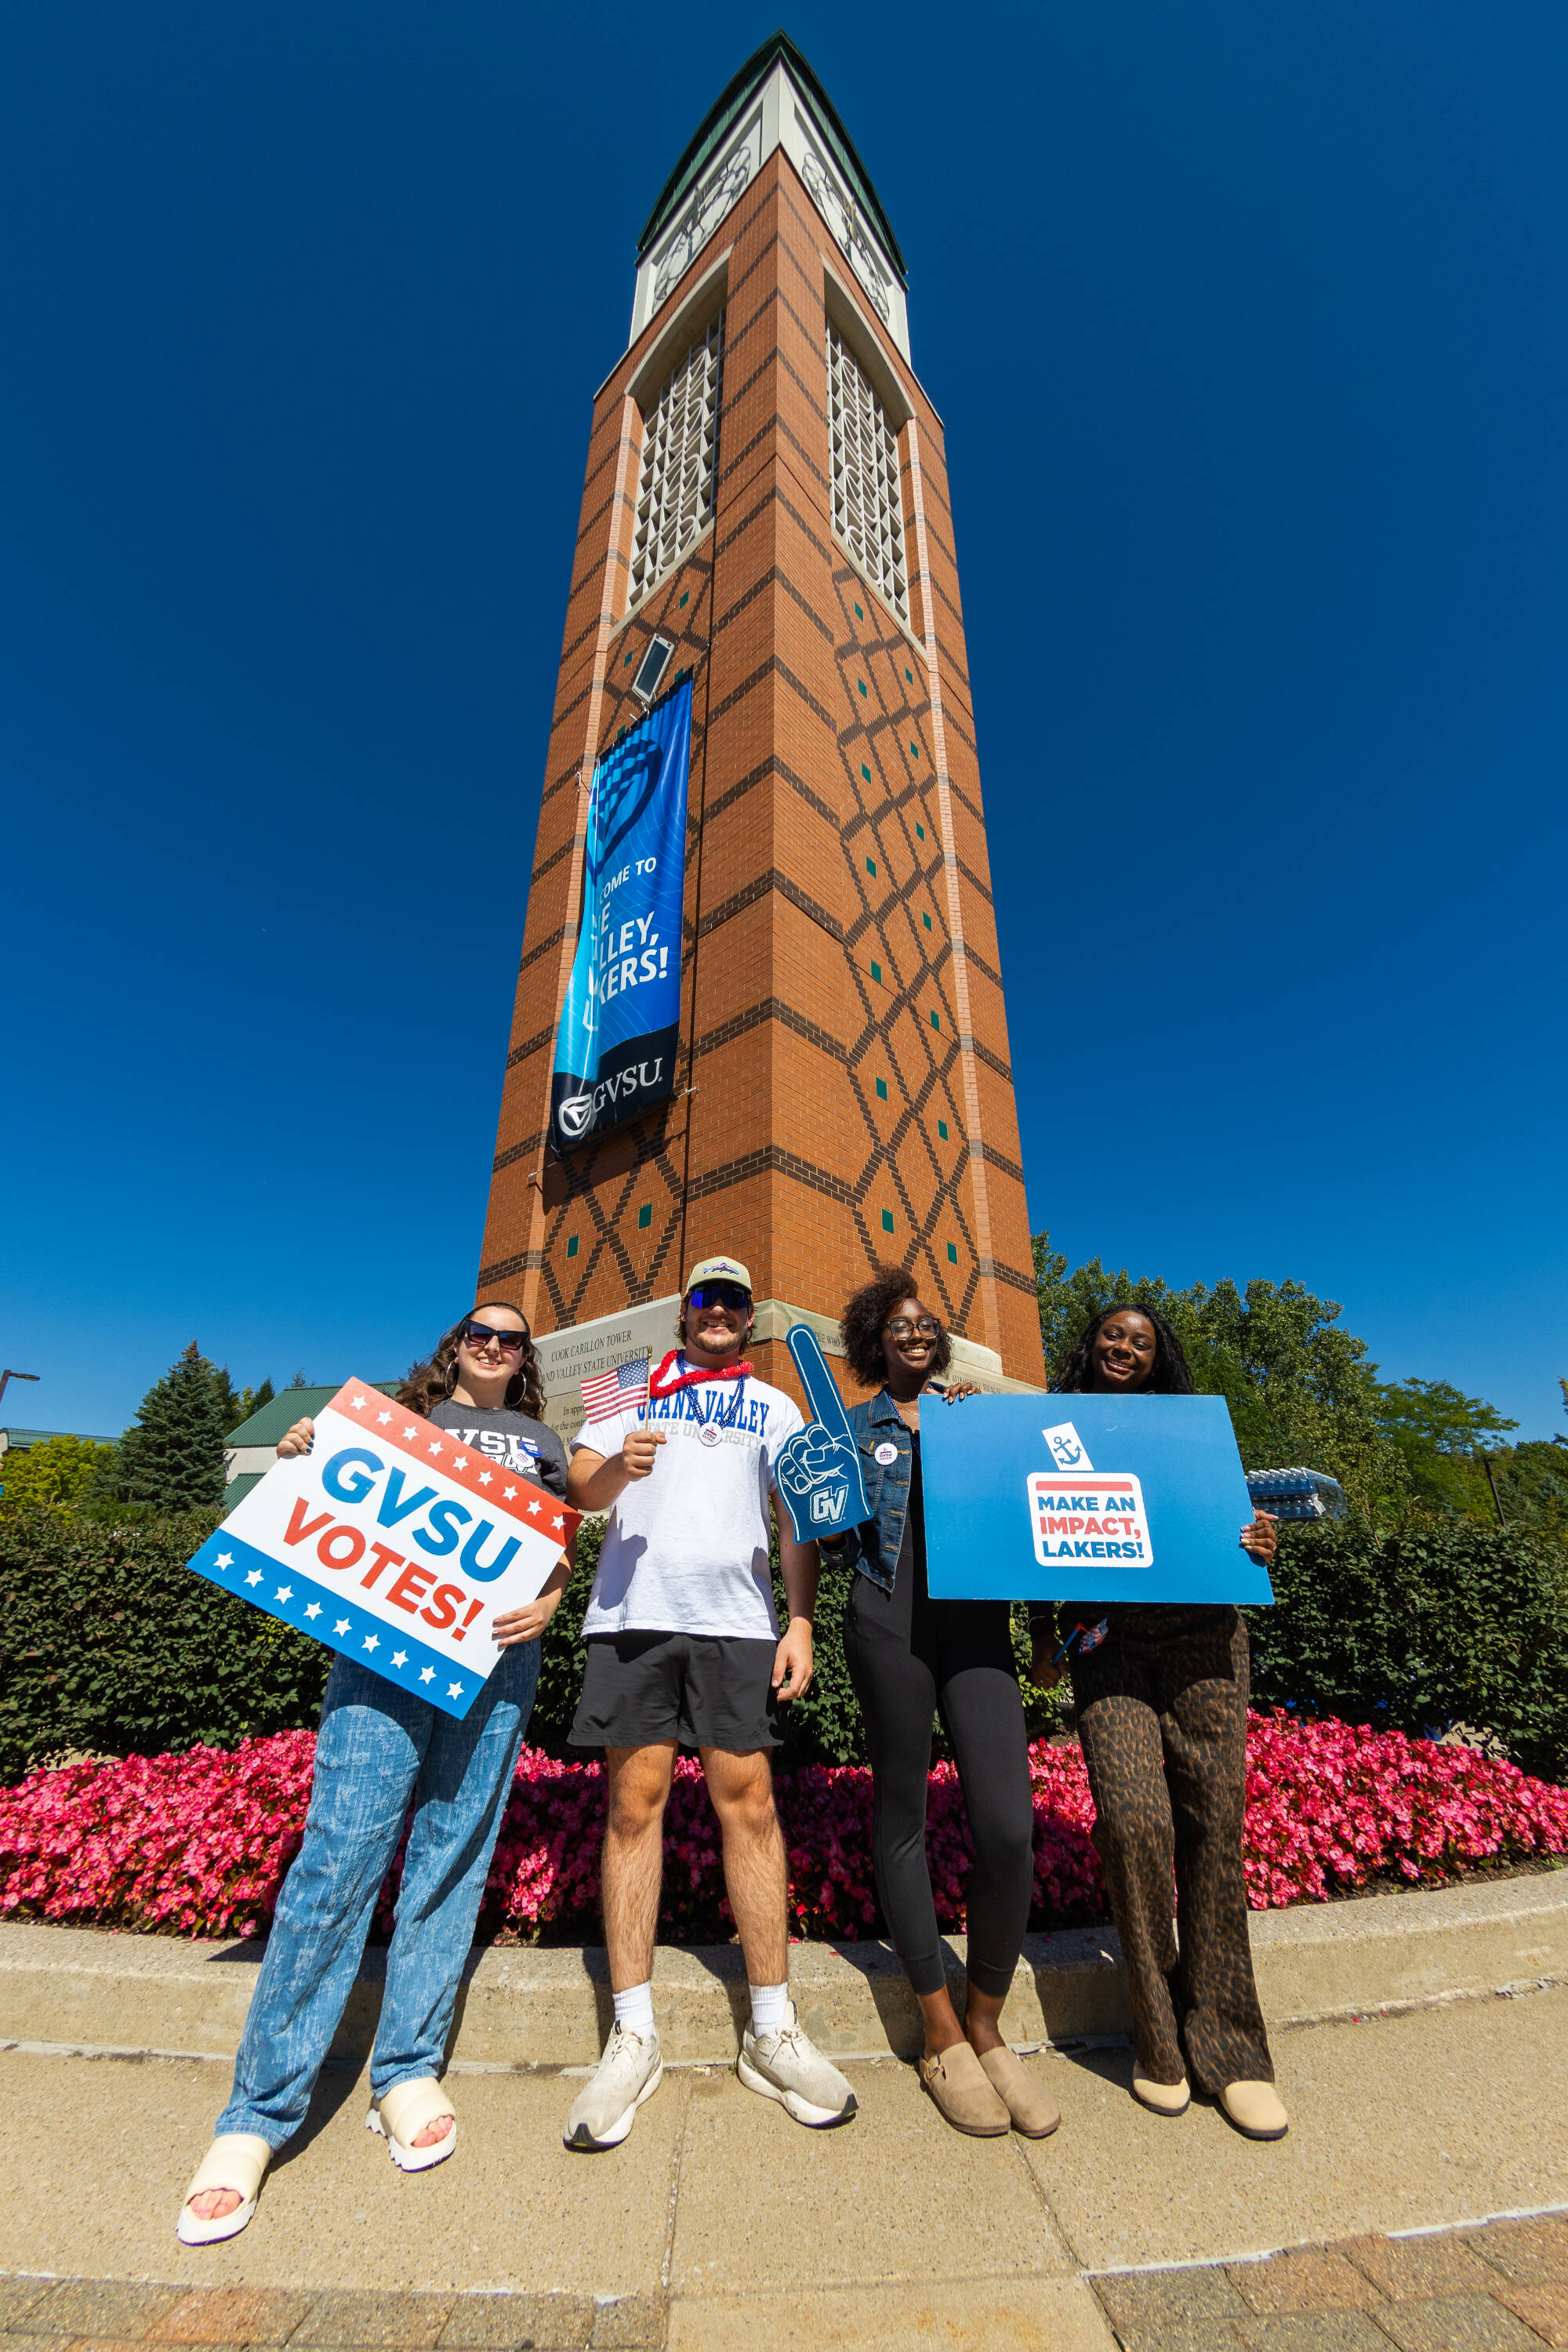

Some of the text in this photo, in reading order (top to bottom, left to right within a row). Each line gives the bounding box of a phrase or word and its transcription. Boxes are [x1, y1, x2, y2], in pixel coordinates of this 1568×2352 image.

[599, 857, 657, 905] COME TO
[591, 1058, 663, 1114] GVSU
[551, 1330, 632, 1363] COOK CARILLON TOWER
[814, 1331, 826, 1344] PLE
[541, 1370, 555, 1384] AND
[556, 1363, 583, 1380] VALLEY
[583, 1358, 605, 1374] STATE
[563, 1406, 569, 1416] In
[706, 1390, 770, 1437] VALLEY
[560, 1421, 569, 1431] the
[322, 1447, 522, 1582] GVSU
[811, 1487, 848, 1523] GV
[1037, 1496, 1136, 1512] MAKE AN
[1040, 1516, 1142, 1540] IMPACT,
[1043, 1541, 1145, 1559] LAKERS!
[283, 1496, 485, 1642] VOTES!
